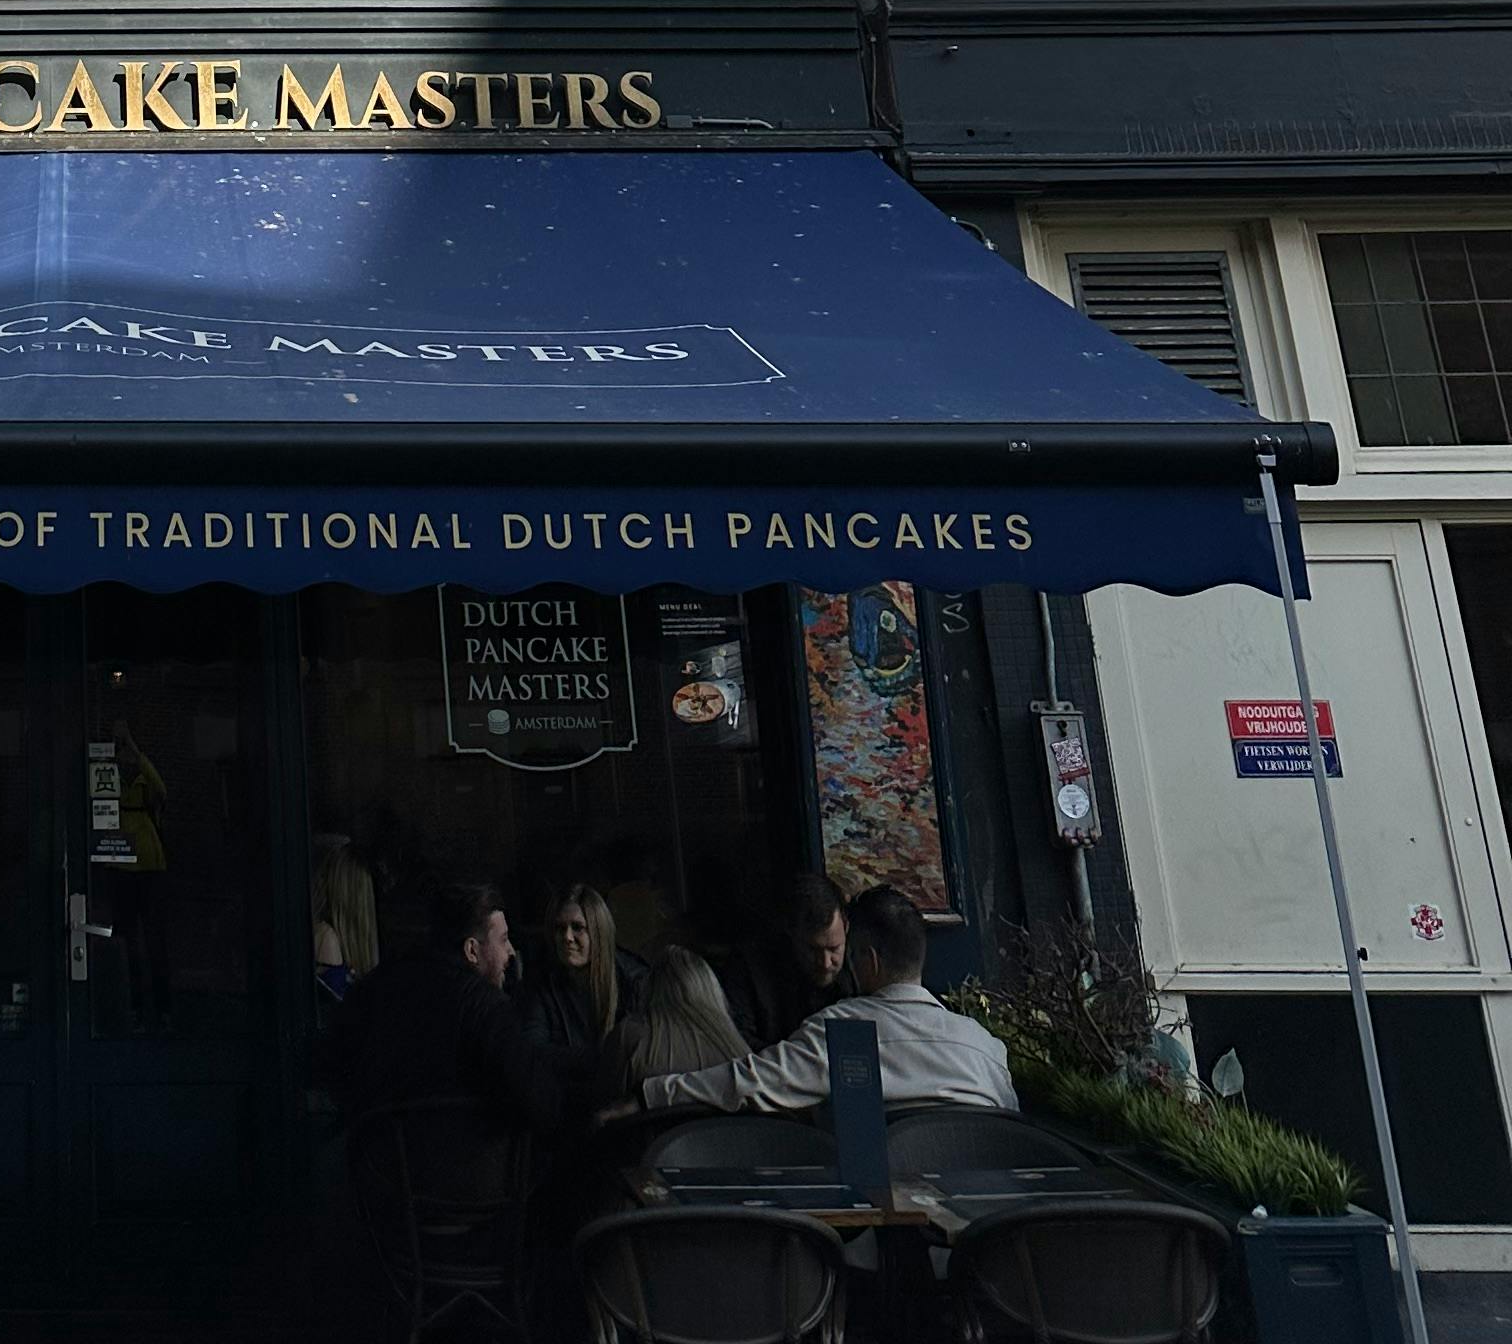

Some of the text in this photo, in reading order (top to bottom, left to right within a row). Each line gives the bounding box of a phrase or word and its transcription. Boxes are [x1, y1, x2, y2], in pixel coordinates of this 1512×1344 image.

[275, 63, 662, 130] MASTERS
[265, 334, 689, 363] MASTERS
[89, 513, 471, 549] TRADITIONAL
[502, 514, 695, 550] DUTCH
[728, 513, 1032, 550] PANCAKES
[463, 601, 578, 628] DUTCH
[466, 637, 609, 664] PANCAKE
[468, 673, 610, 701] MASTERS
[515, 715, 598, 730] AMSTERDAM
